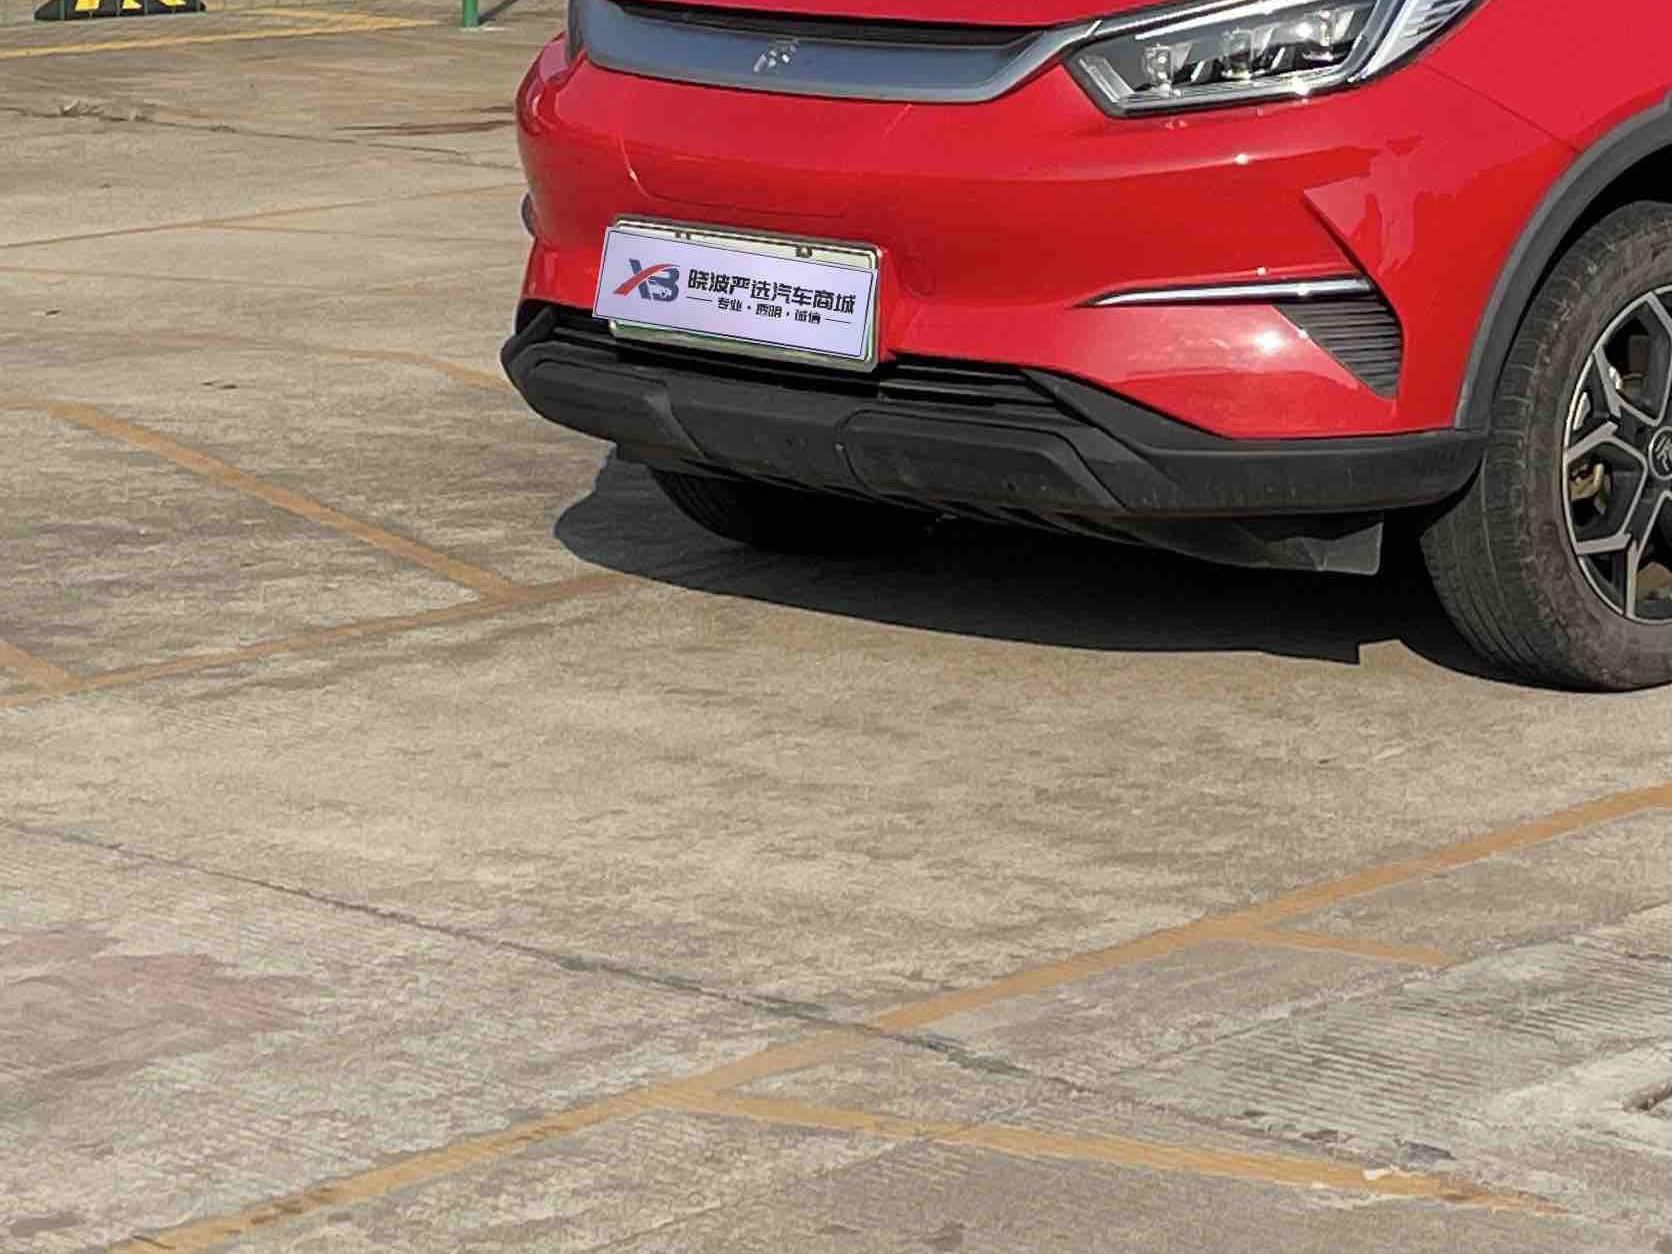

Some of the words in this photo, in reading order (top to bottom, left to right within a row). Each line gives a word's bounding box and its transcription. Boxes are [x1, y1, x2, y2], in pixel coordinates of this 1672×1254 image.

[687, 269, 856, 315] 晓波严选汽车商城
